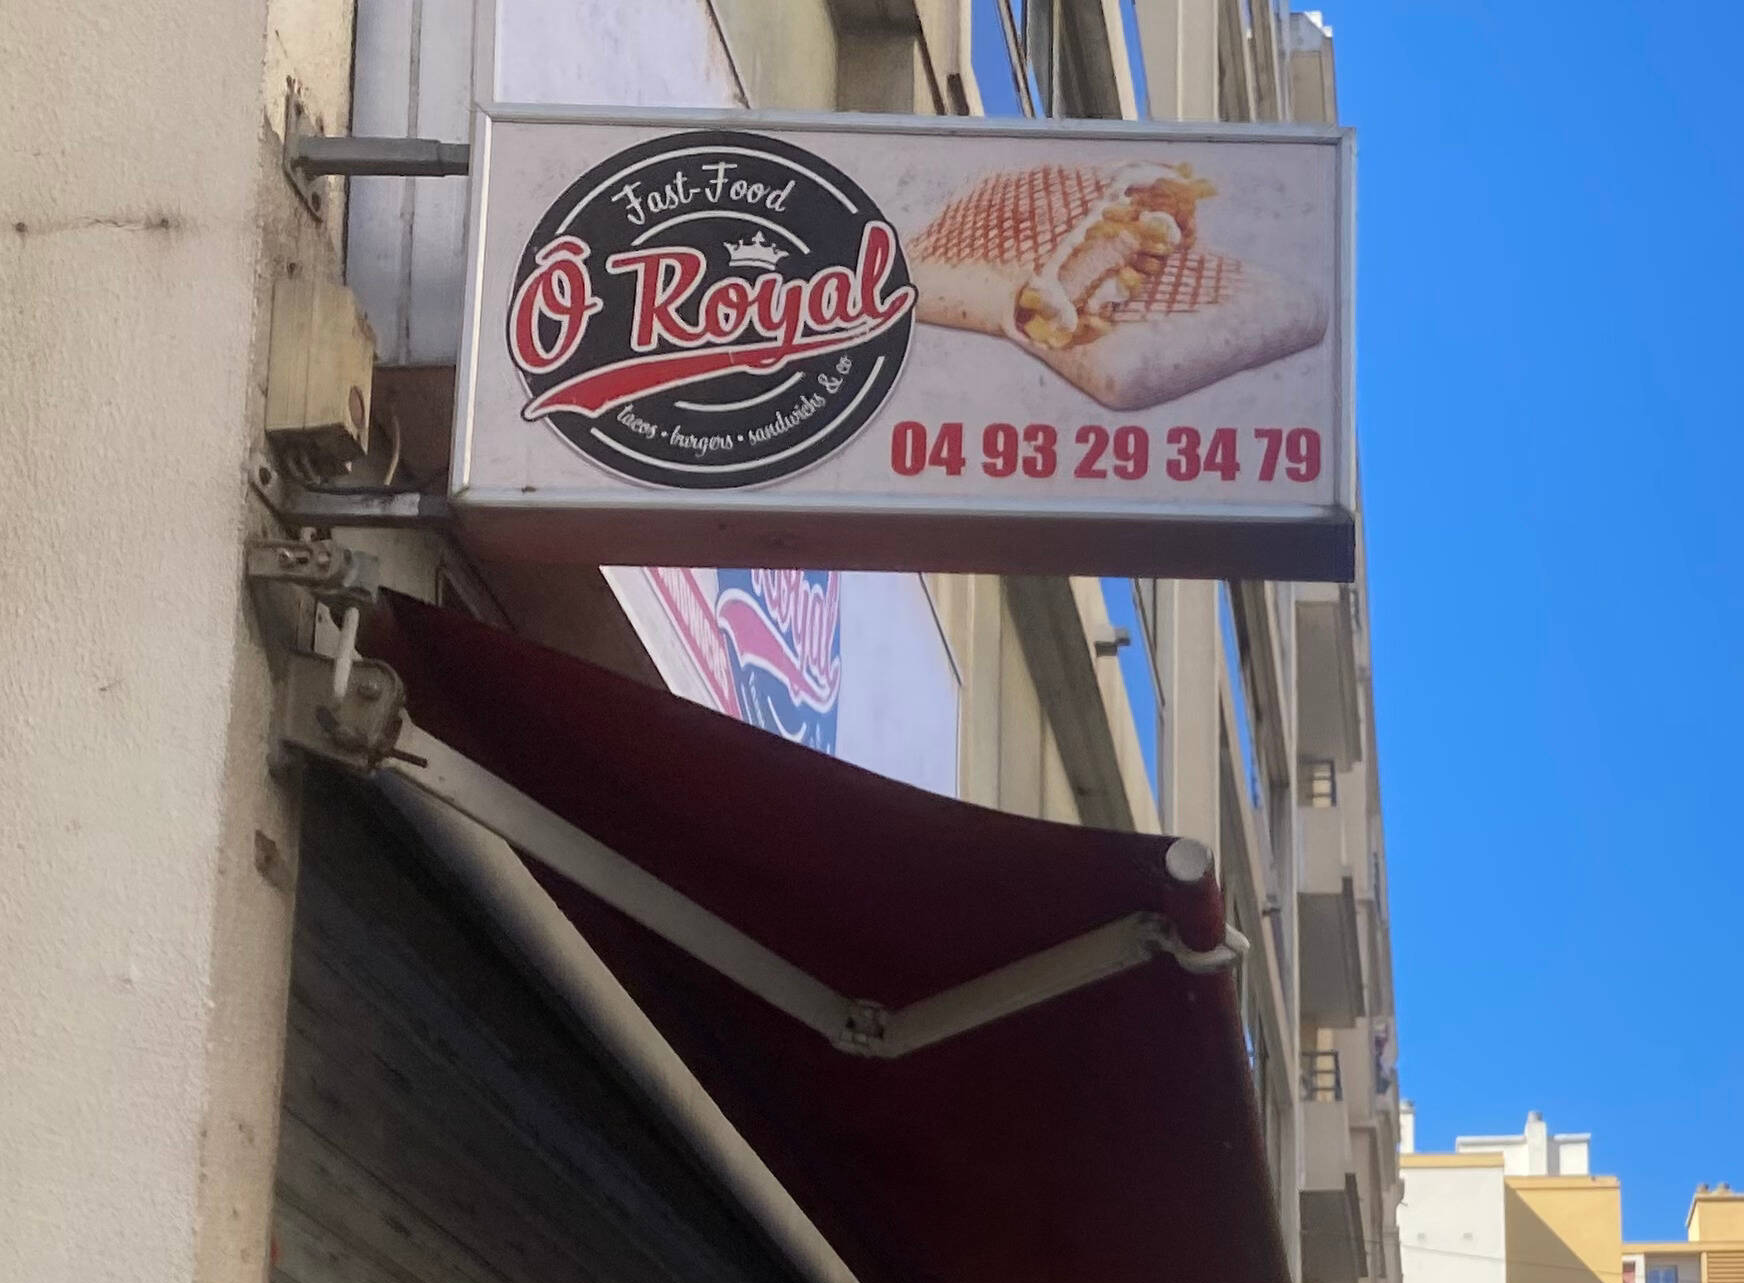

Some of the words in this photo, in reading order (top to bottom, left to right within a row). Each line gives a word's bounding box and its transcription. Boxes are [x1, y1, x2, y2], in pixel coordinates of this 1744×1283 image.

[611, 161, 796, 225] Fast-Food
[507, 235, 603, 375] Ô
[605, 220, 918, 373] Royal
[616, 404, 658, 438] tacos
[669, 425, 734, 457] burgers
[817, 373, 844, 394] &
[891, 421, 967, 476] 04
[981, 423, 1058, 478] 93
[1073, 425, 1150, 480] 29
[1166, 426, 1241, 481] 34
[1253, 427, 1322, 482] 79
